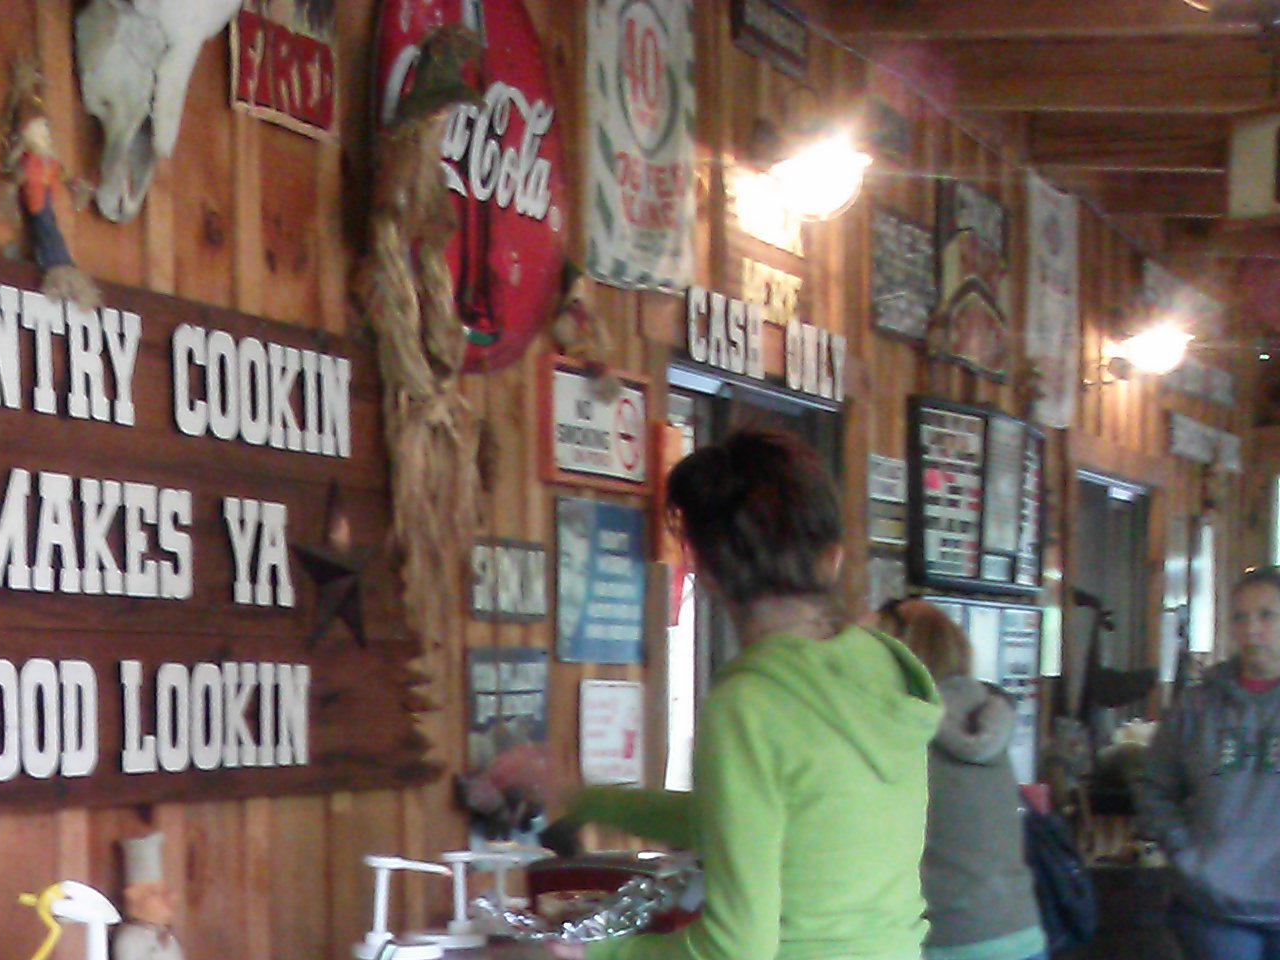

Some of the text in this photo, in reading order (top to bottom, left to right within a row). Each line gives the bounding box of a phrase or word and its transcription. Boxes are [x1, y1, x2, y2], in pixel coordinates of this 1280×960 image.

[688, 286, 765, 380] CASH
[173, 323, 351, 459] COOKIN
[224, 496, 296, 607] YA
[120, 660, 311, 774] LOOKIN
